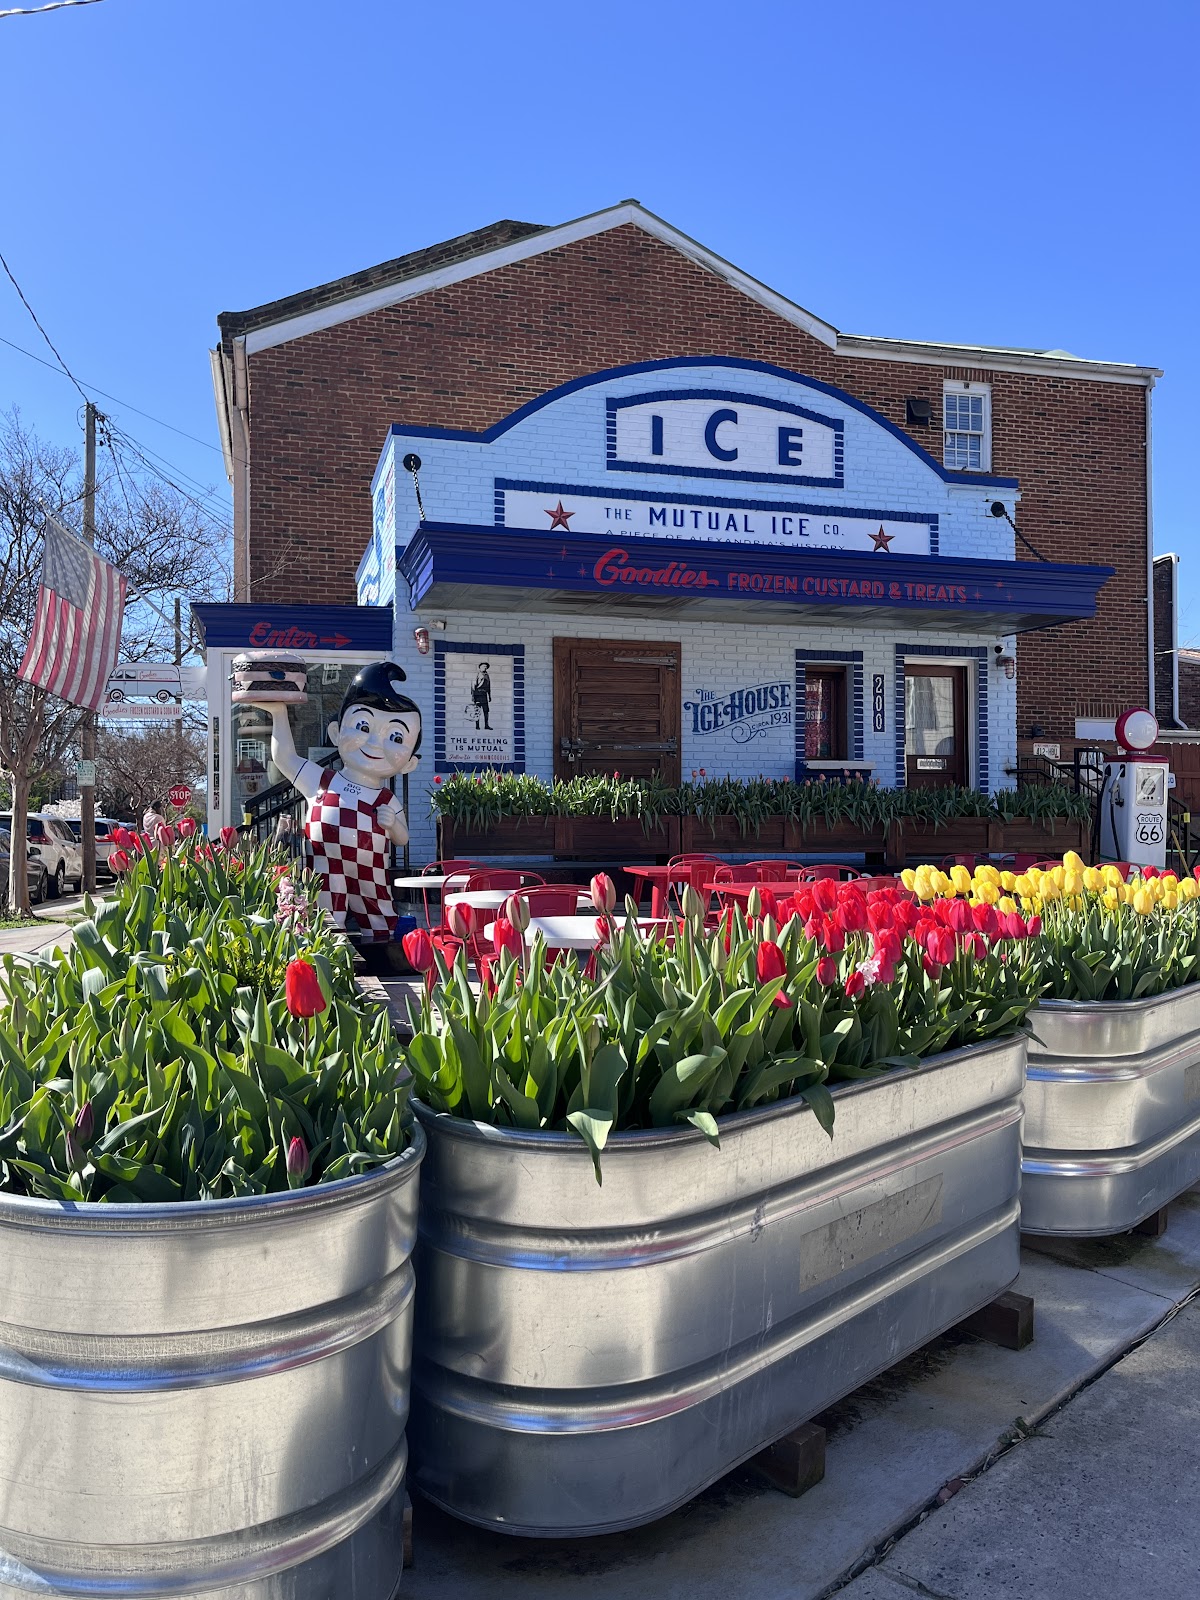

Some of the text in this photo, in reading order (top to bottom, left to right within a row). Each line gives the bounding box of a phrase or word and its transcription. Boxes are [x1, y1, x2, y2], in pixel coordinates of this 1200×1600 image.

[651, 408, 803, 466] ICE
[603, 506, 845, 537] THE MUTUAL ICE CO.
[593, 548, 967, 603] Goodies FROZEN CUSTARD & TREATS
[249, 622, 318, 648] Enter
[696, 688, 716, 701] THE
[103, 704, 128, 717] Goodies
[130, 706, 143, 715] FROZEN
[144, 706, 159, 715] CUSTARD
[683, 684, 791, 733] ICE HOUSE
[770, 711, 792, 725] 1931
[170, 790, 190, 800] STOP
[343, 786, 362, 796] BOY
[1139, 825, 1160, 842] 66
